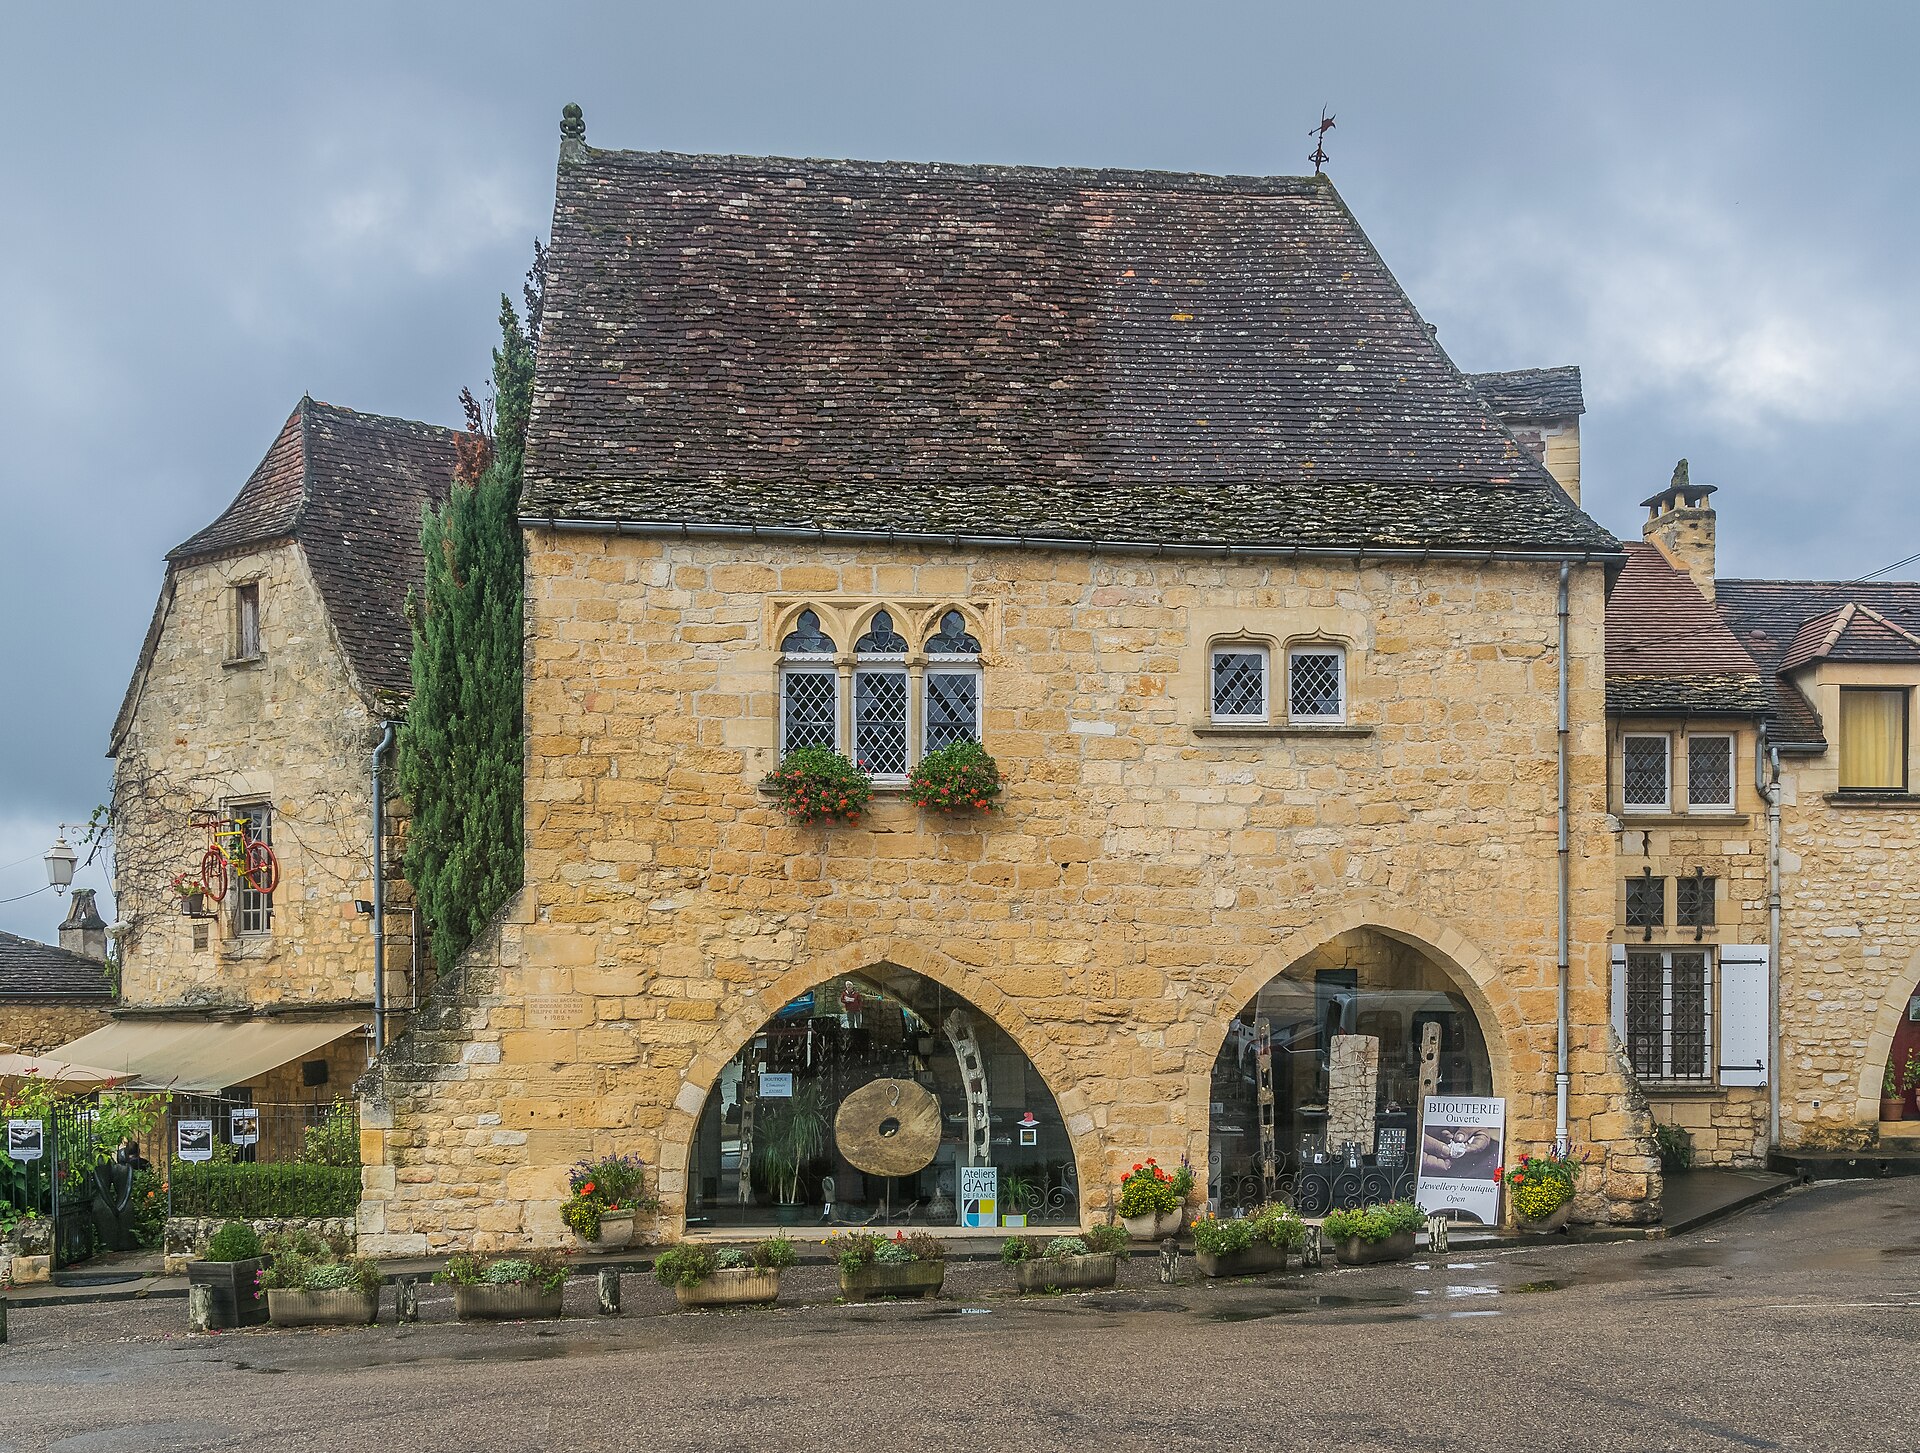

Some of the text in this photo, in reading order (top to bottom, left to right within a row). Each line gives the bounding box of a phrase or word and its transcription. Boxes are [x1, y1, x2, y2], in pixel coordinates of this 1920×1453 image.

[1428, 1102, 1500, 1114] BIJOUTERIE
[1446, 1114, 1480, 1124] Ouverte
[963, 1168, 996, 1178] Ateliers
[963, 1178, 995, 1192] d'Art
[1420, 1182, 1496, 1194] Jewellery boutique
[1446, 1194, 1466, 1204] Open
